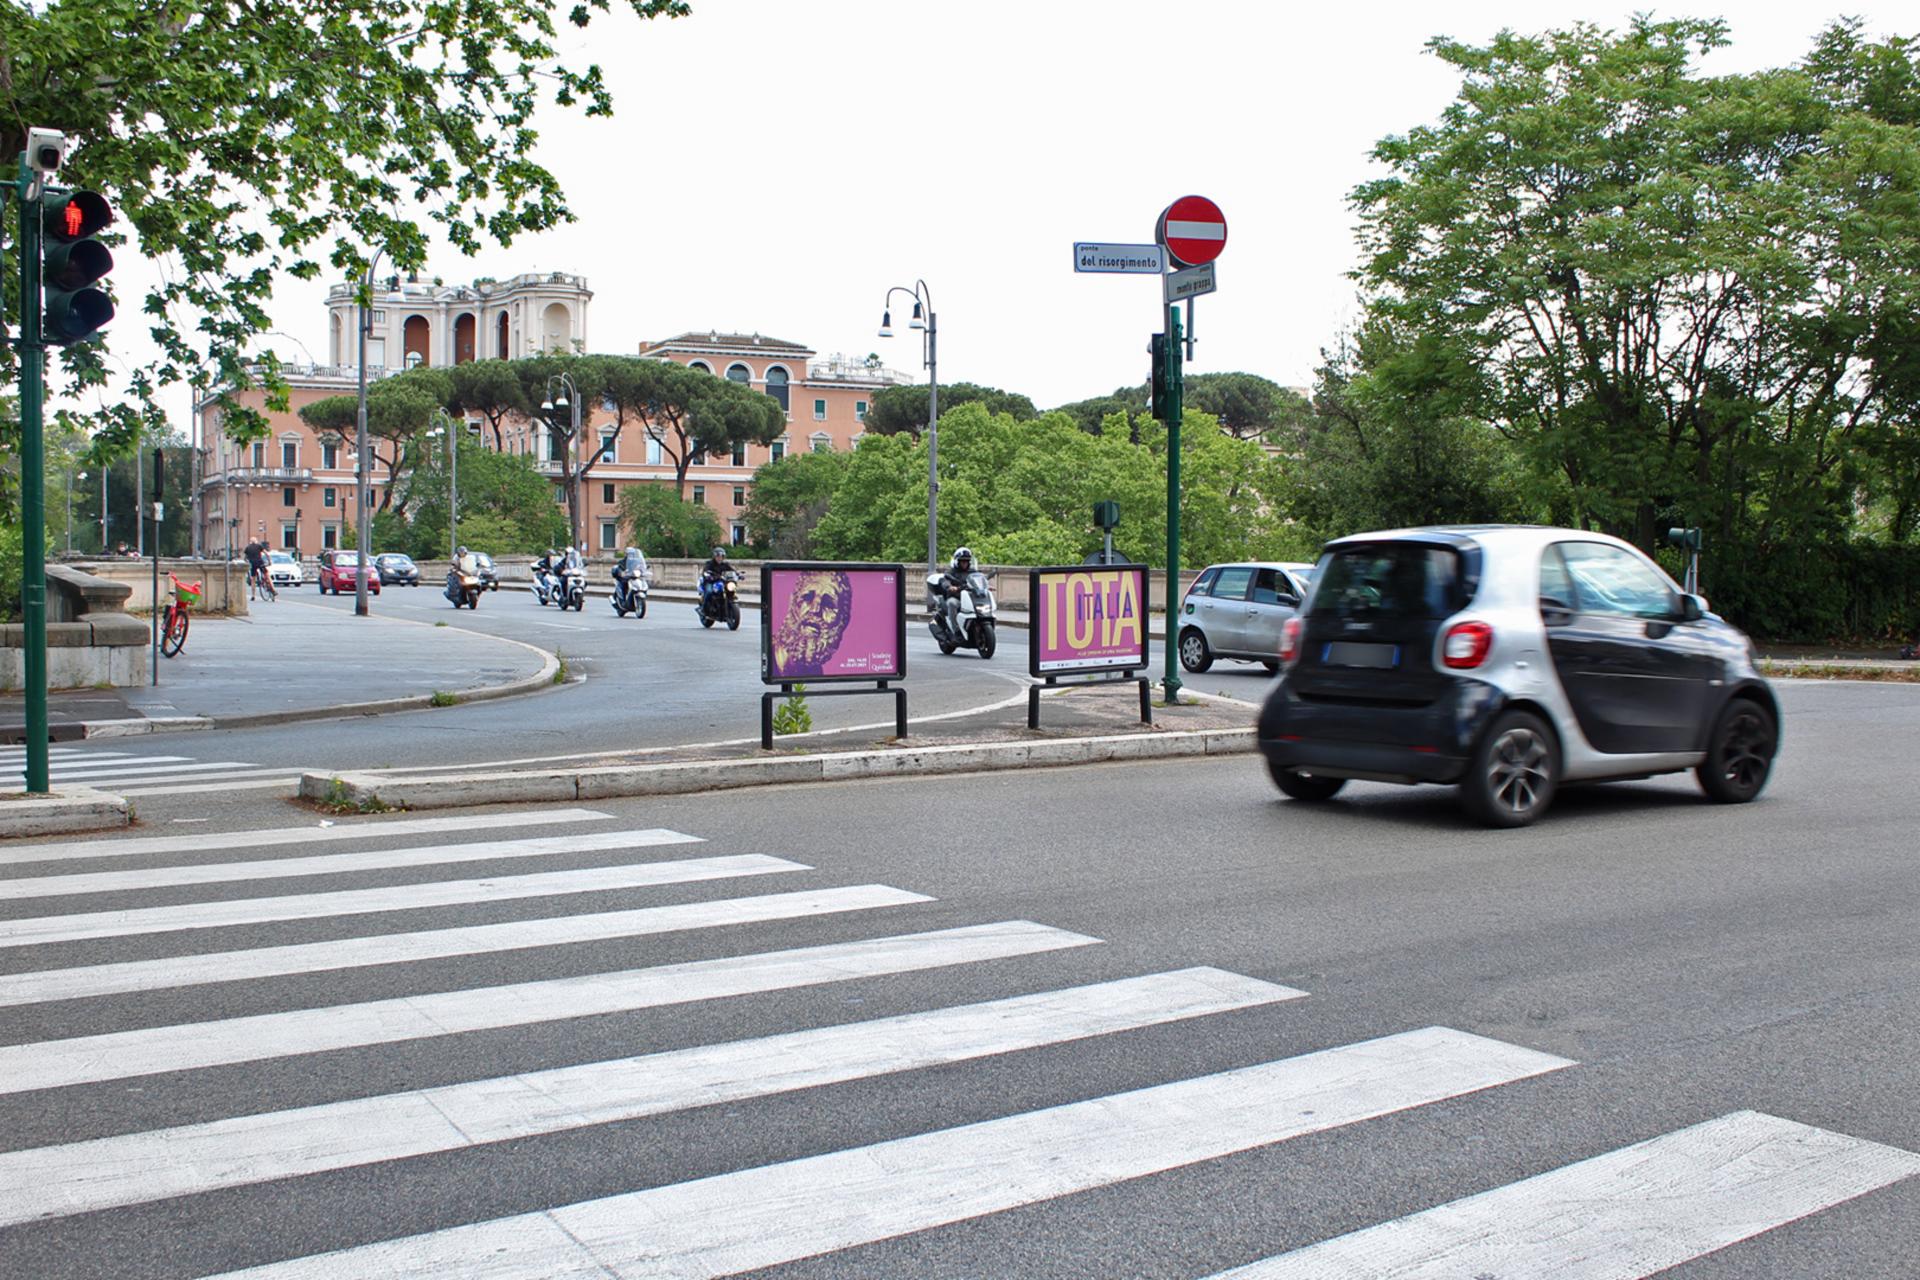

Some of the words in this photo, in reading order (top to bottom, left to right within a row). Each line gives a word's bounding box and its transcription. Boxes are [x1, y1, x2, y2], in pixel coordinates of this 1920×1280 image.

[1081, 255, 1096, 267] del
[1098, 256, 1157, 270] risorgimento
[1040, 571, 1141, 650] TOTA
[1078, 592, 1133, 620] ITALIA
